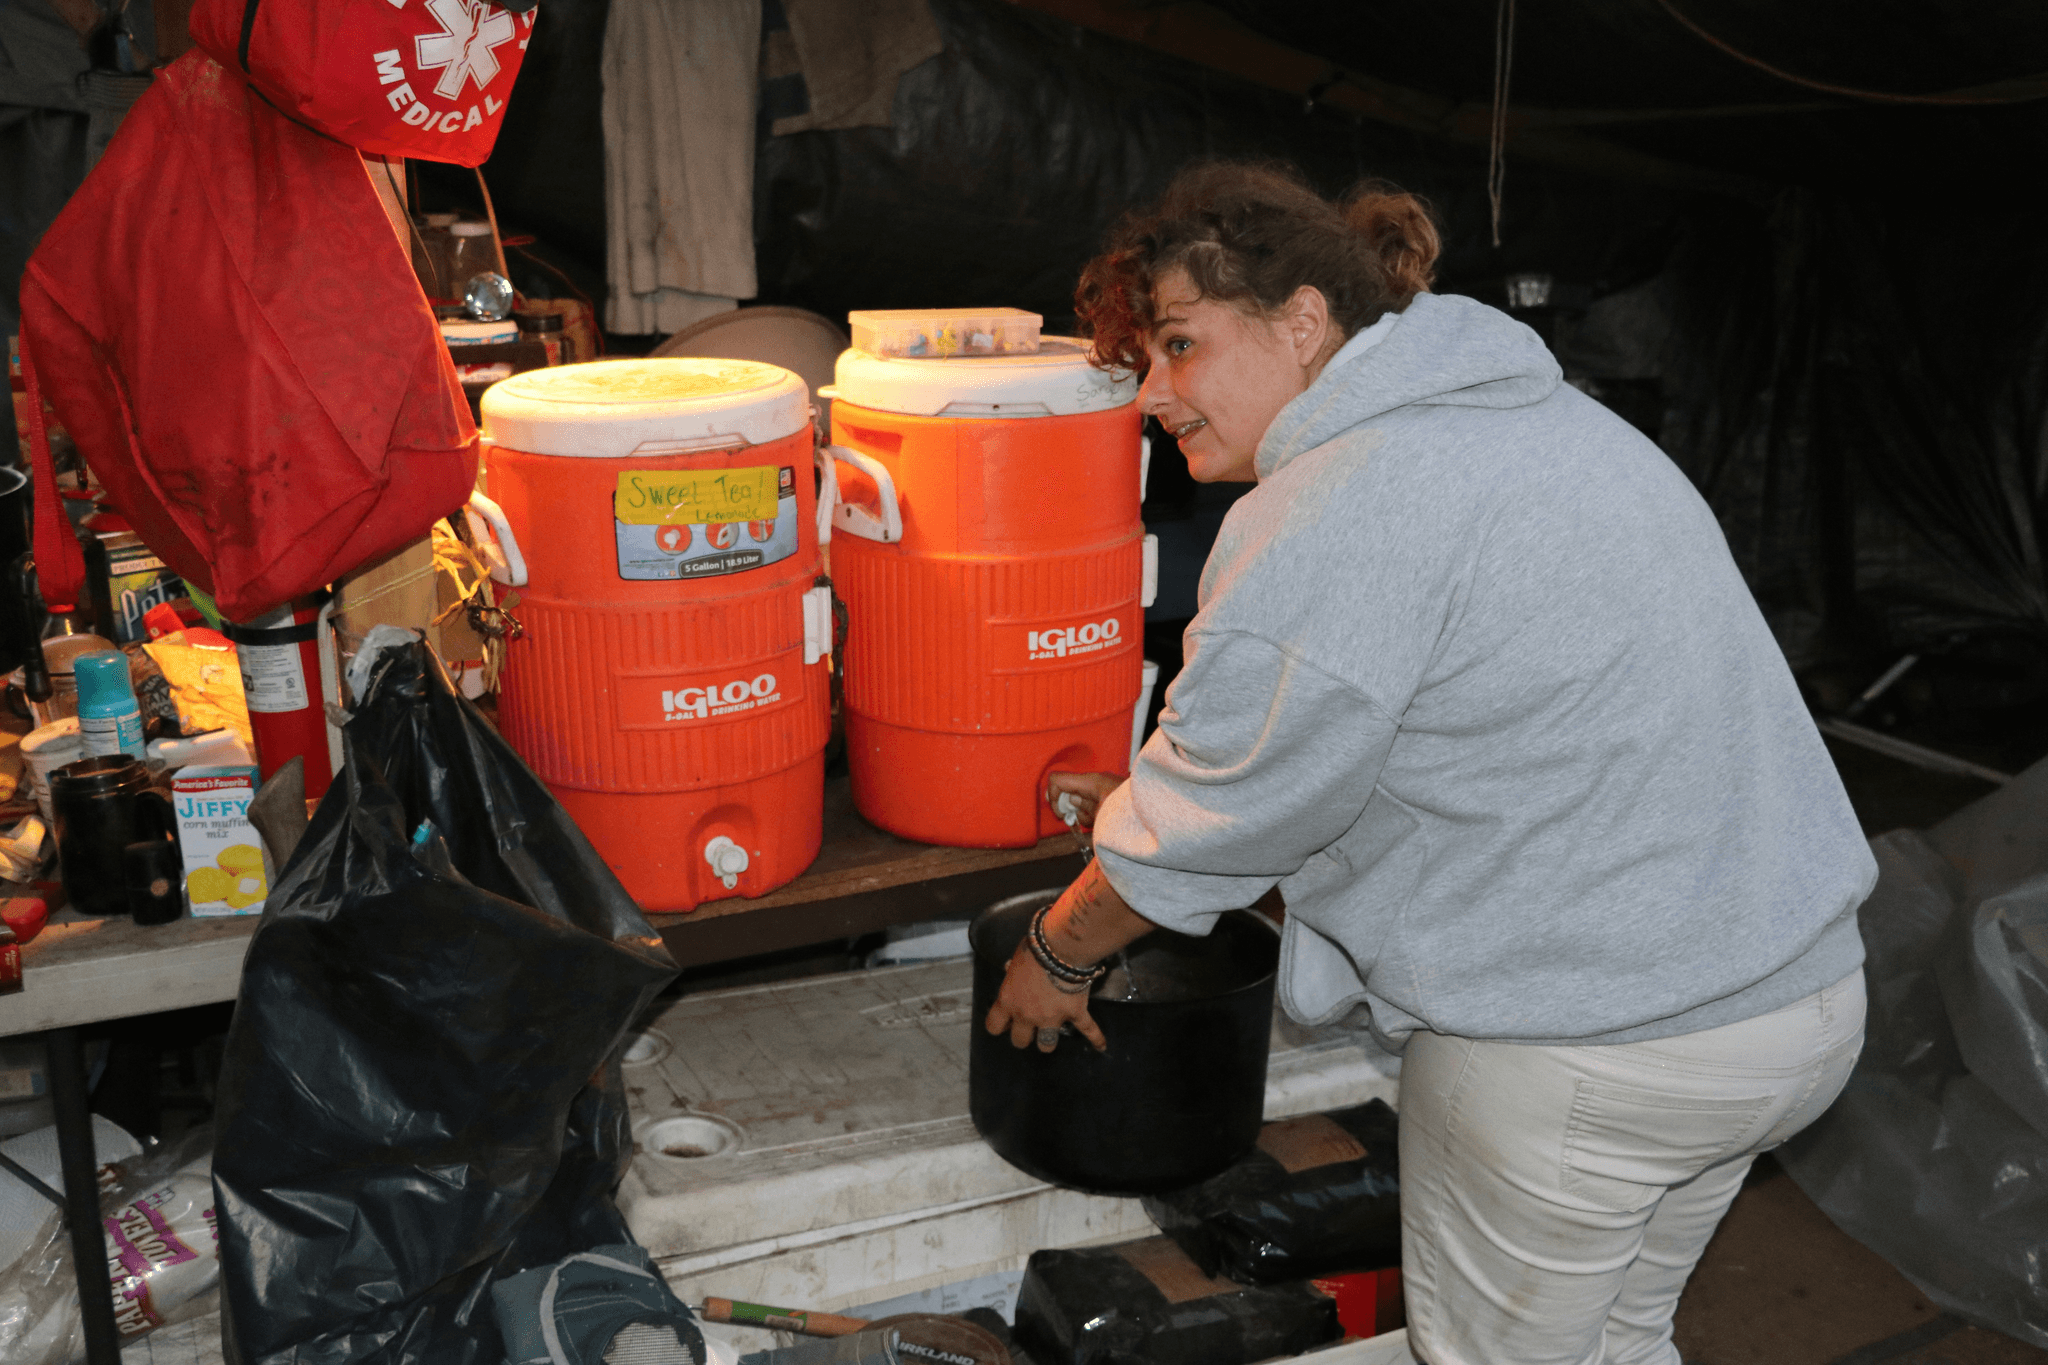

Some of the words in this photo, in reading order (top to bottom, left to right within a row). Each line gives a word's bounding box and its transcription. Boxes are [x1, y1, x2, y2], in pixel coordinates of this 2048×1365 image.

[373, 48, 503, 134] MEDICAL
[627, 476, 702, 508] Sweet
[685, 564, 691, 573] 5
[692, 560, 720, 572] Gallon
[726, 558, 742, 568] 18.9
[743, 555, 759, 565] Liter
[1028, 618, 1120, 658] IGLOO
[661, 673, 776, 718] IGLOO
[711, 700, 756, 716] DRINKING
[756, 692, 781, 707] WATER
[174, 780, 213, 789] America's
[214, 779, 249, 788] Favorite
[178, 797, 250, 819] JIFFY
[183, 819, 209, 830] corn
[211, 816, 251, 829] muffin
[206, 828, 229, 839] mix
